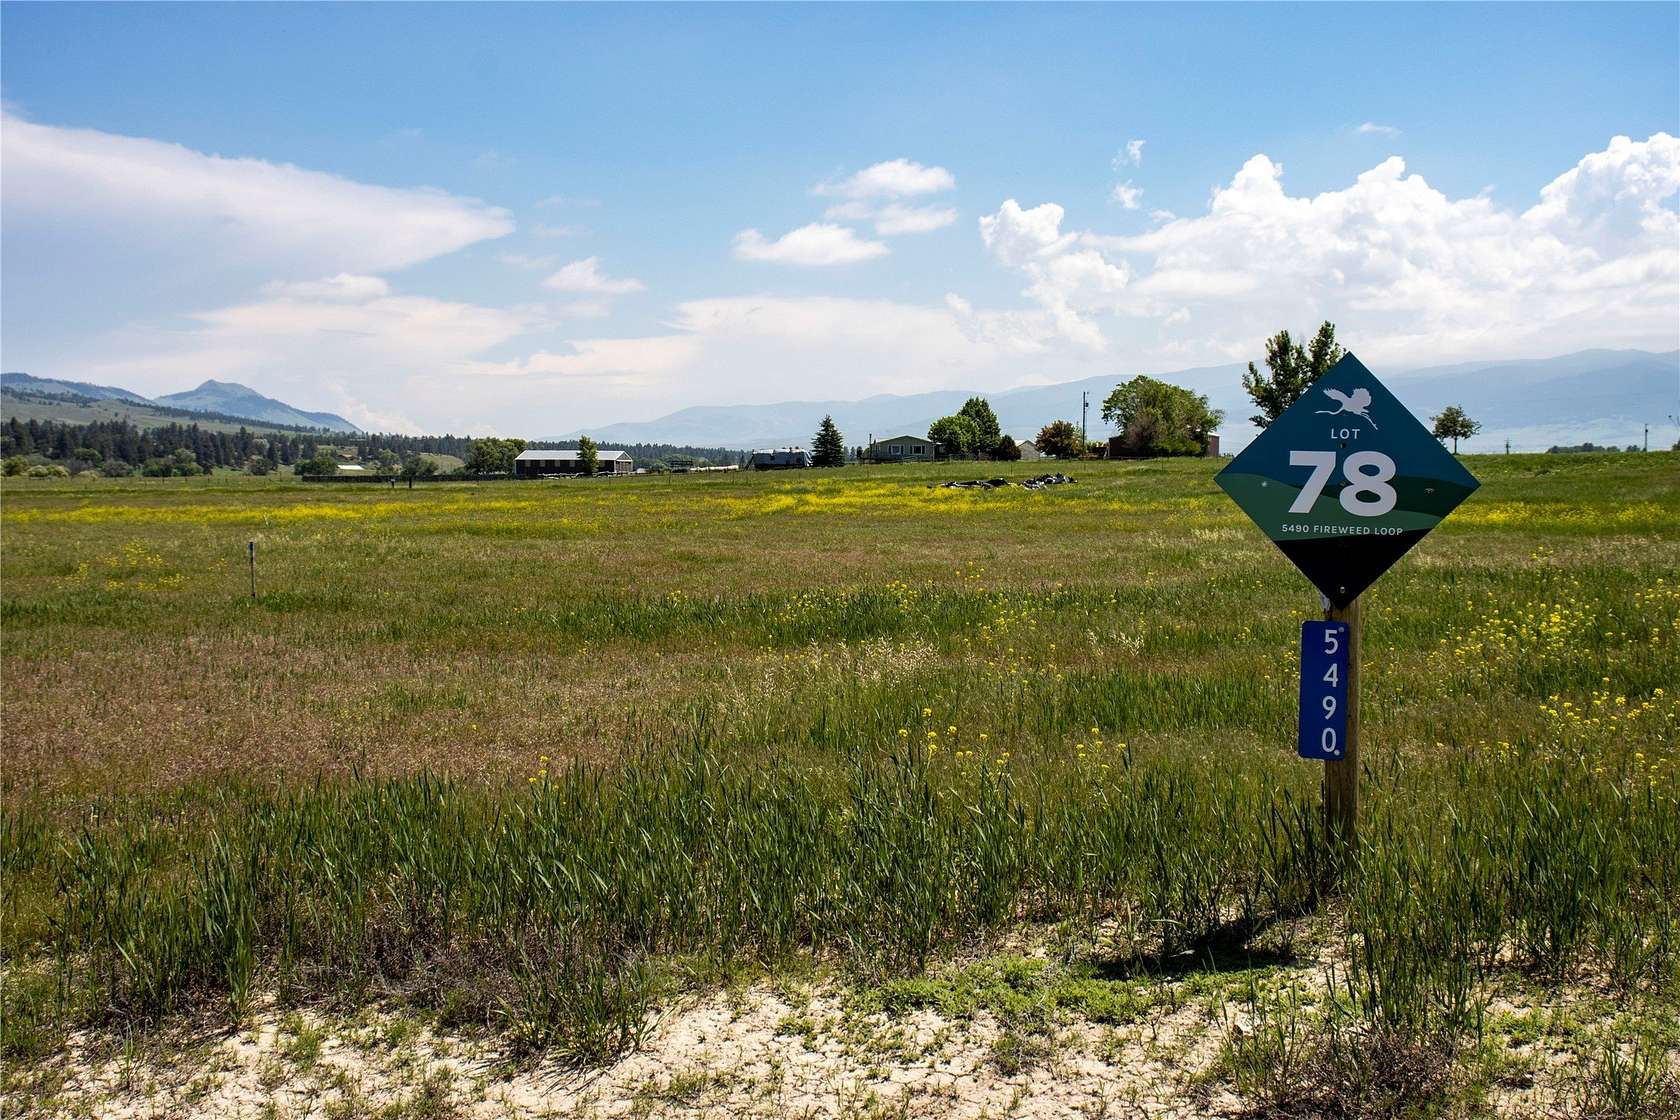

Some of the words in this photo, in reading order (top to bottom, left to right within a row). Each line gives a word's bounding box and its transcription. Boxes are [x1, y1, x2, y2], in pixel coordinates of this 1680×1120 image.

[1331, 428, 1360, 440] LOT
[1288, 450, 1397, 517] 78
[1281, 524, 1310, 533] 5490
[1313, 525, 1371, 535] FIREWEED
[1374, 527, 1403, 536] LOOP
[1321, 629, 1339, 753] 5490
